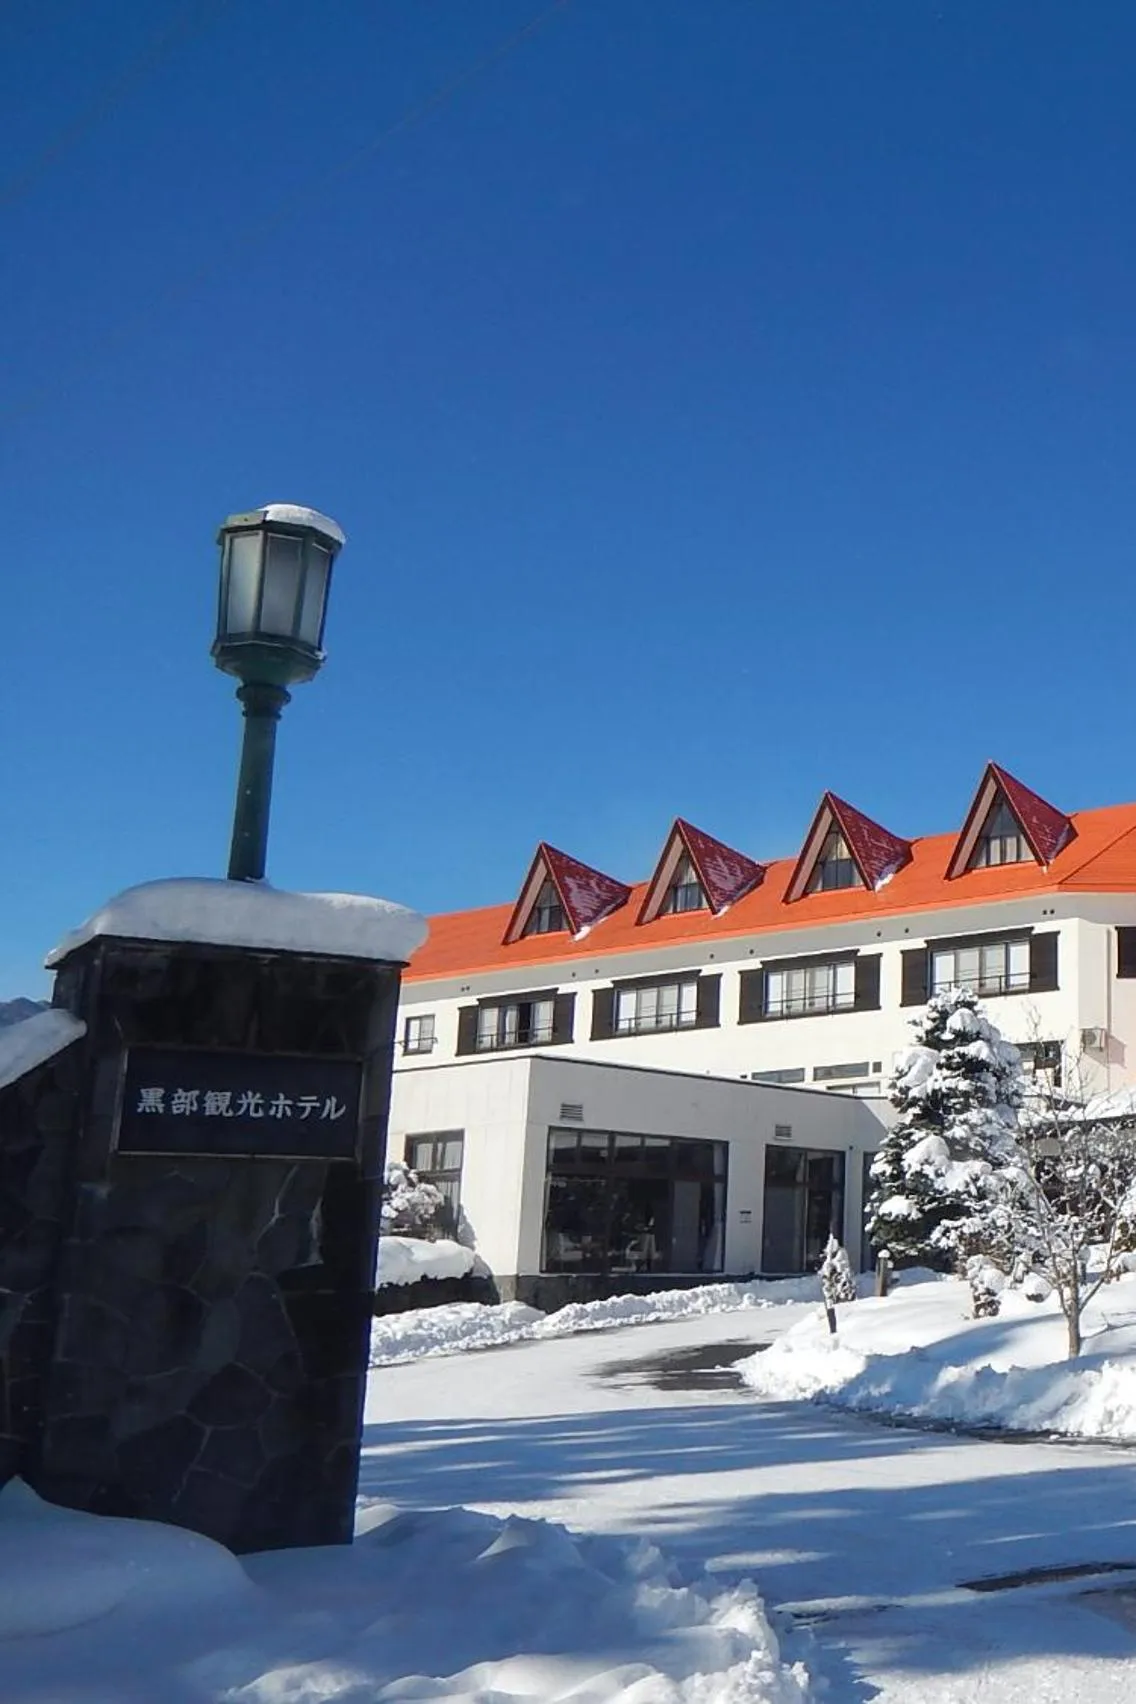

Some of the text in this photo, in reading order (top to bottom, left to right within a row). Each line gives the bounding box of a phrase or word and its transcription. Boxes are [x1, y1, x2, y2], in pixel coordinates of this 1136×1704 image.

[136, 1087, 347, 1121] 黒部観光ホテル
